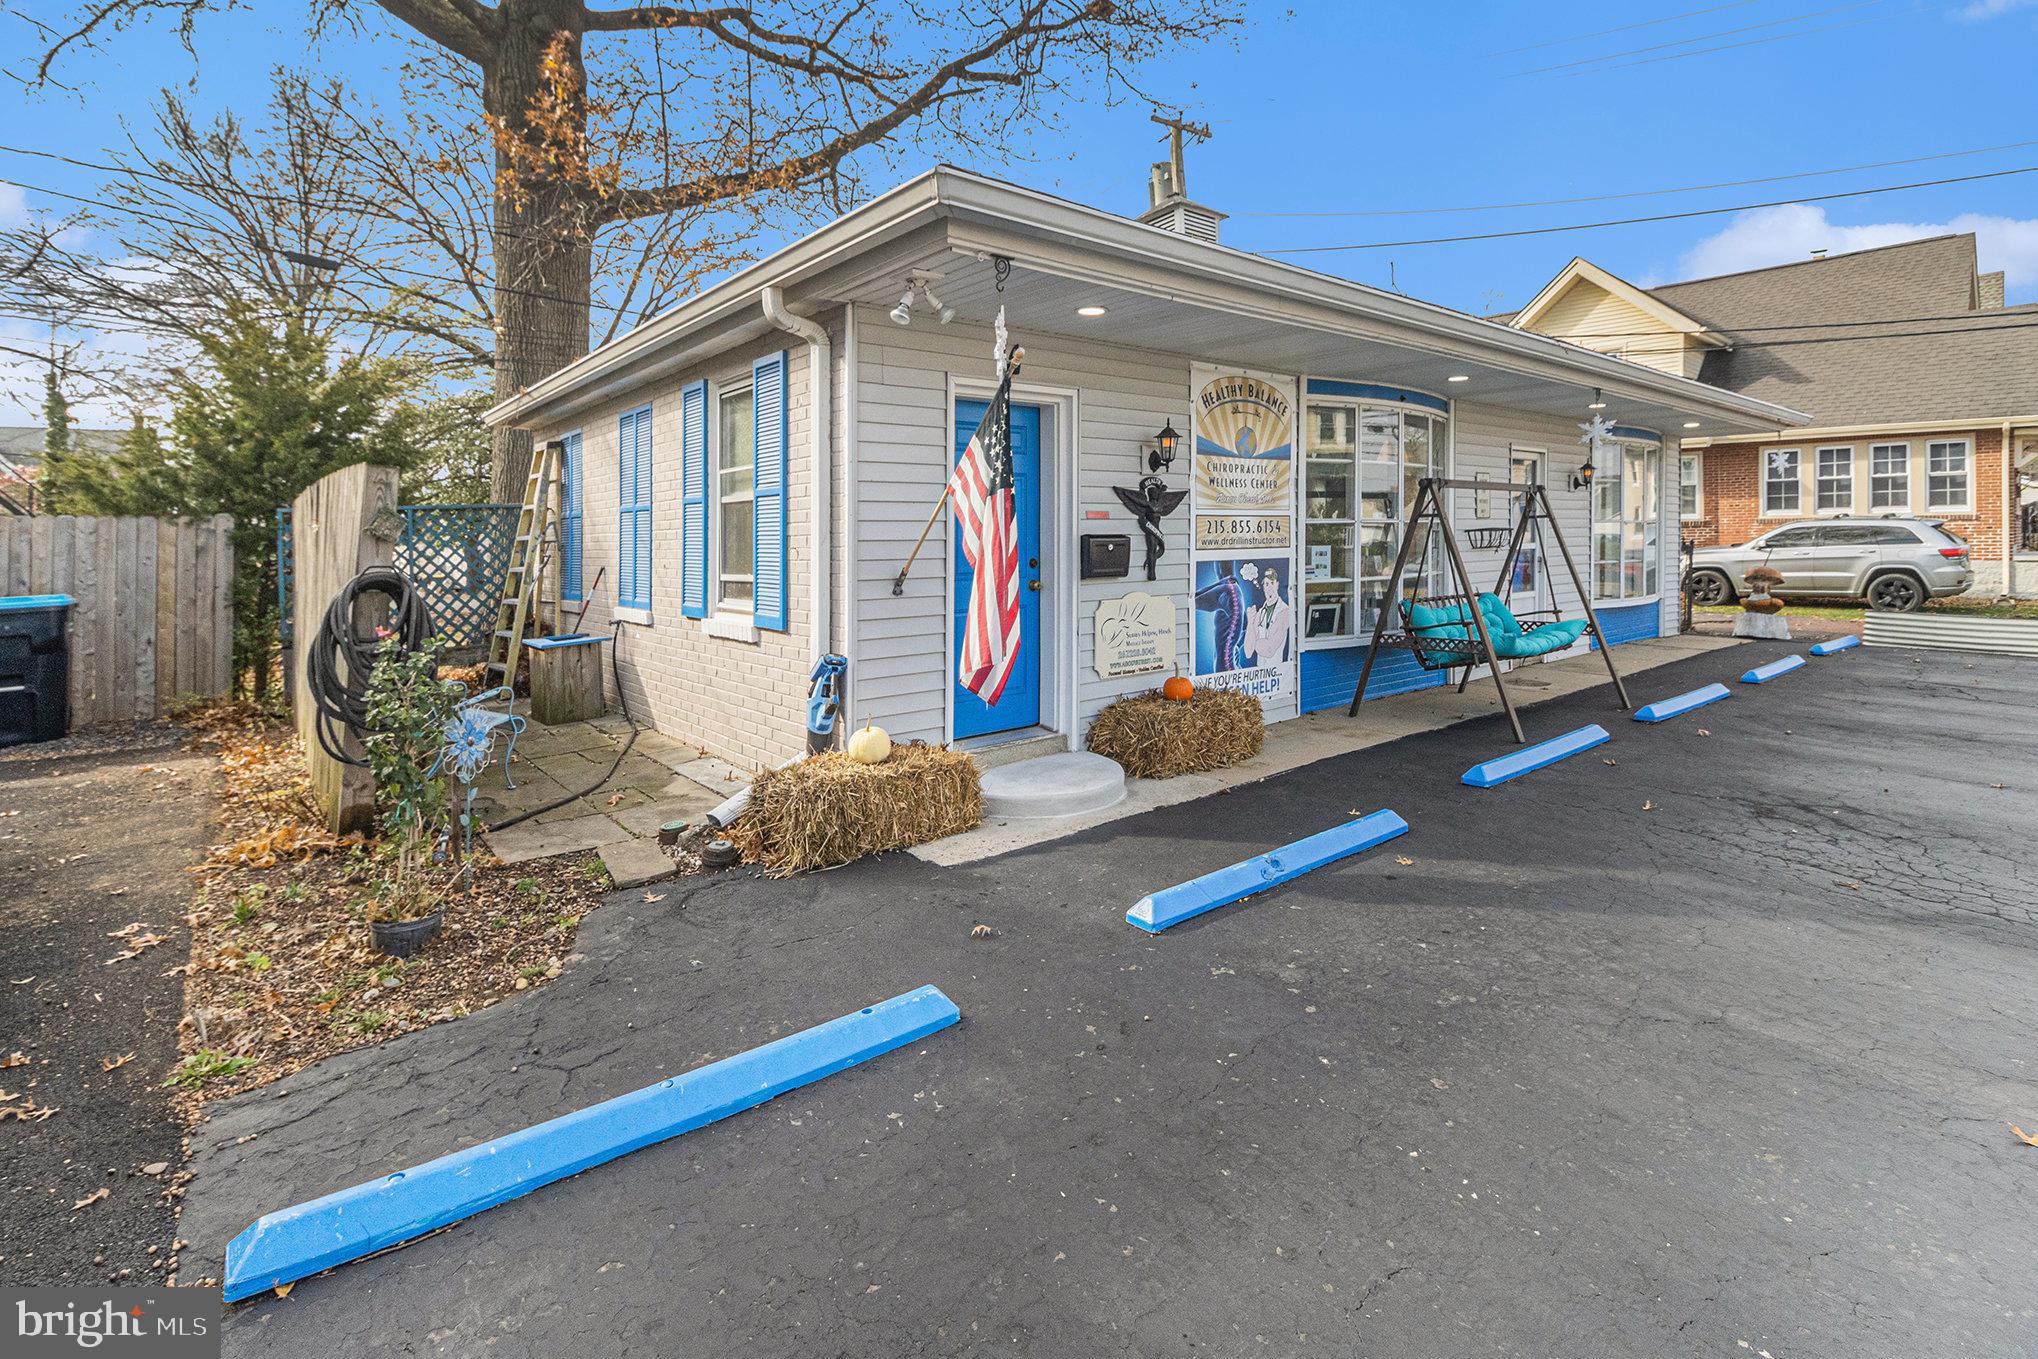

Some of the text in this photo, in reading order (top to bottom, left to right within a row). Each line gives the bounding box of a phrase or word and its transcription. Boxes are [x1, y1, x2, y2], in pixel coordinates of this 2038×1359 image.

[1201, 384, 1288, 417] HEALTHY BALANCE
[1207, 461, 1268, 475] CHIROPRACTIC
[1208, 476, 1278, 489] WELLNESS CENTER
[1207, 520, 1281, 534] 215.855.6154
[1201, 537, 1287, 546] www.drdrillinstructor.net
[1213, 672, 1242, 688] YOU'RE
[1243, 666, 1283, 682] HURTING...
[1252, 678, 1280, 696] HELP!
